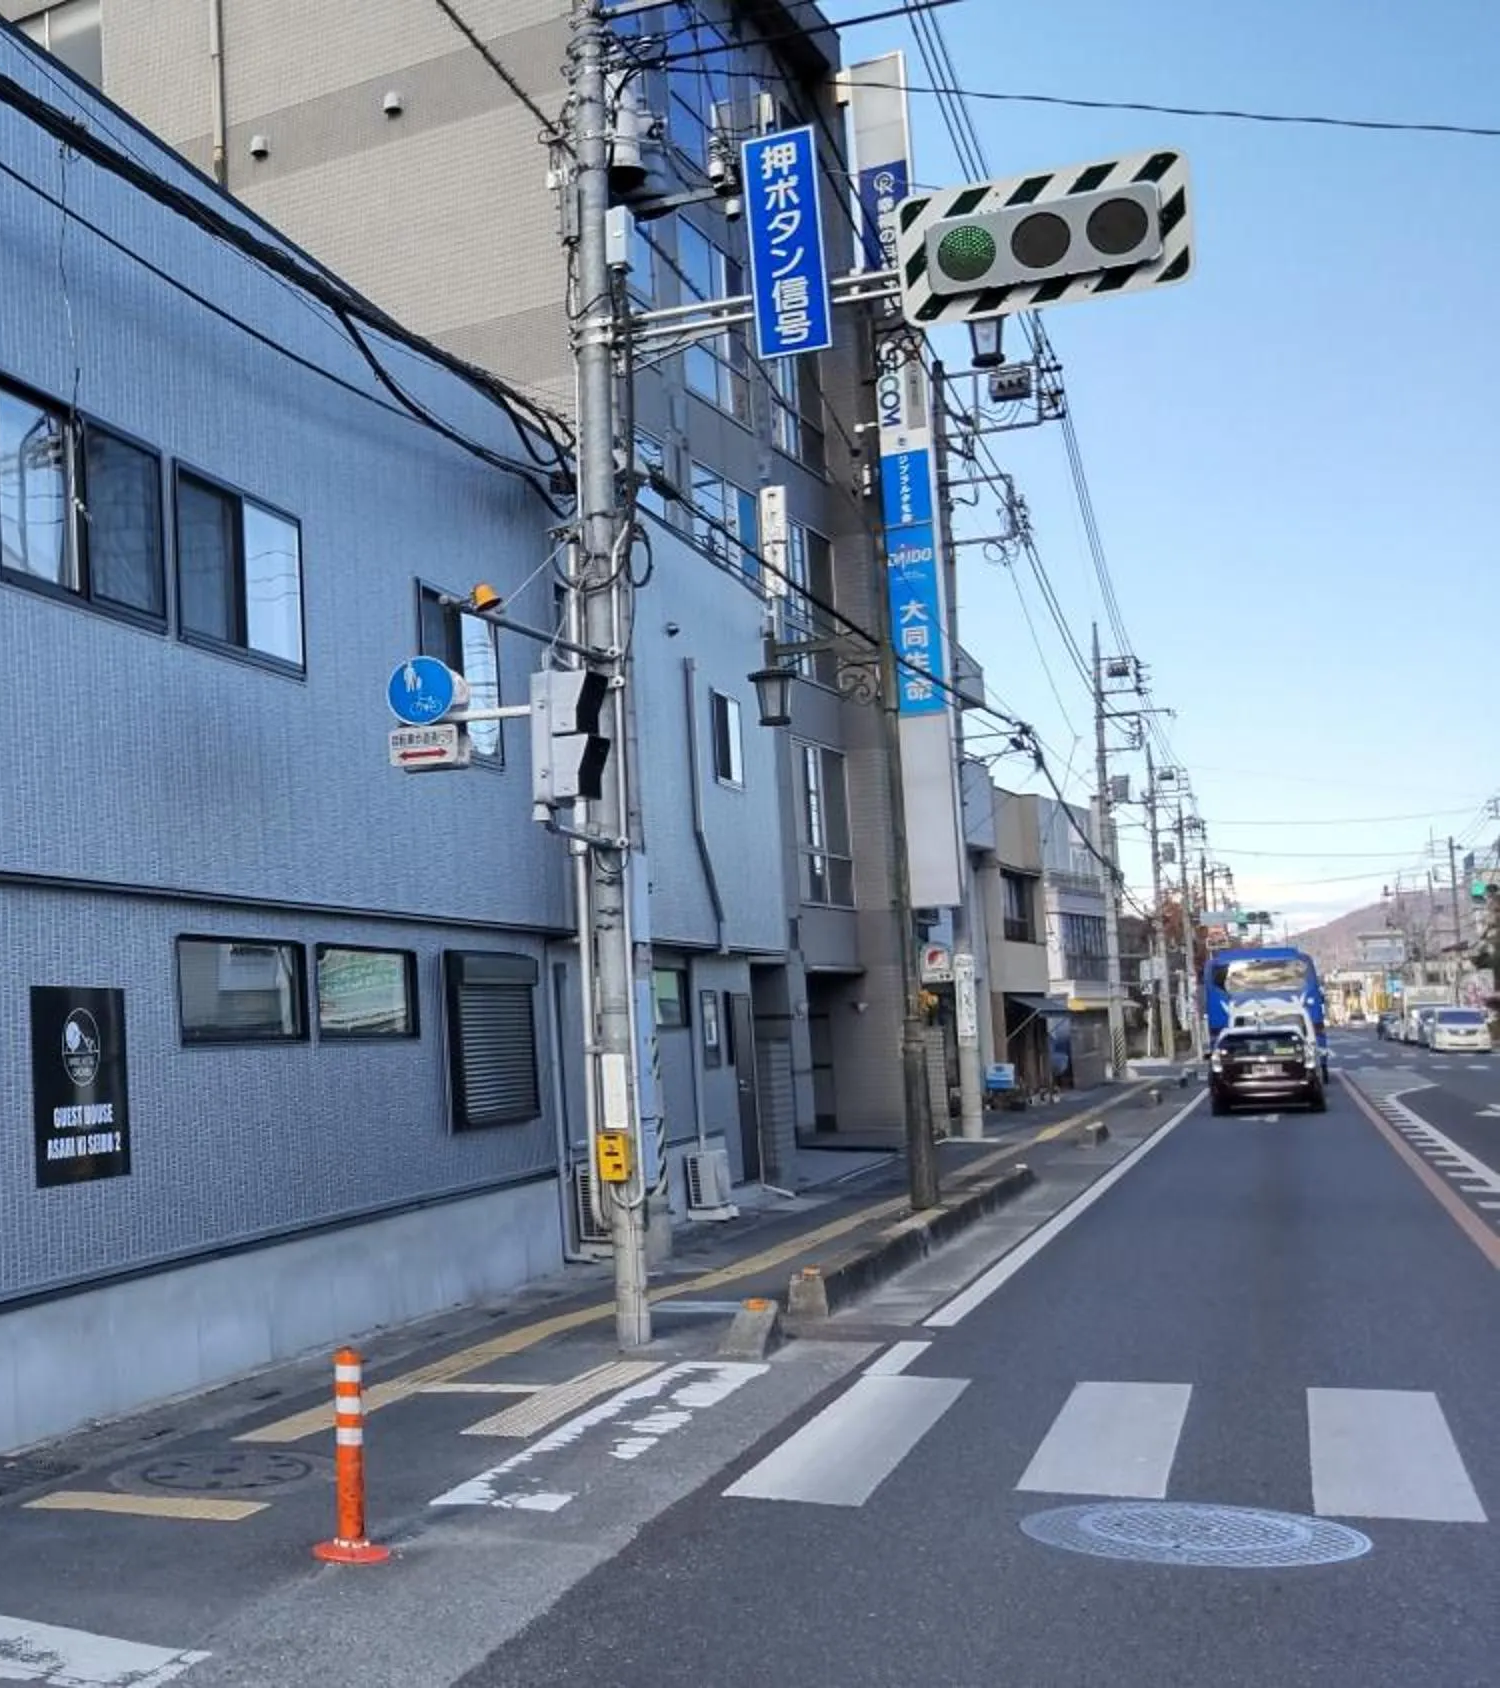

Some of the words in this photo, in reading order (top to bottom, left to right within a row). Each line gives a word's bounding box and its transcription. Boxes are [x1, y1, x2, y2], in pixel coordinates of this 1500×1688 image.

[760, 141, 812, 345] 押ボタン信号
[899, 599, 933, 700] 大同生命
[53, 1105, 82, 1128] GUEST
[83, 1103, 113, 1125] HOUSE
[115, 1131, 121, 1151] 2
